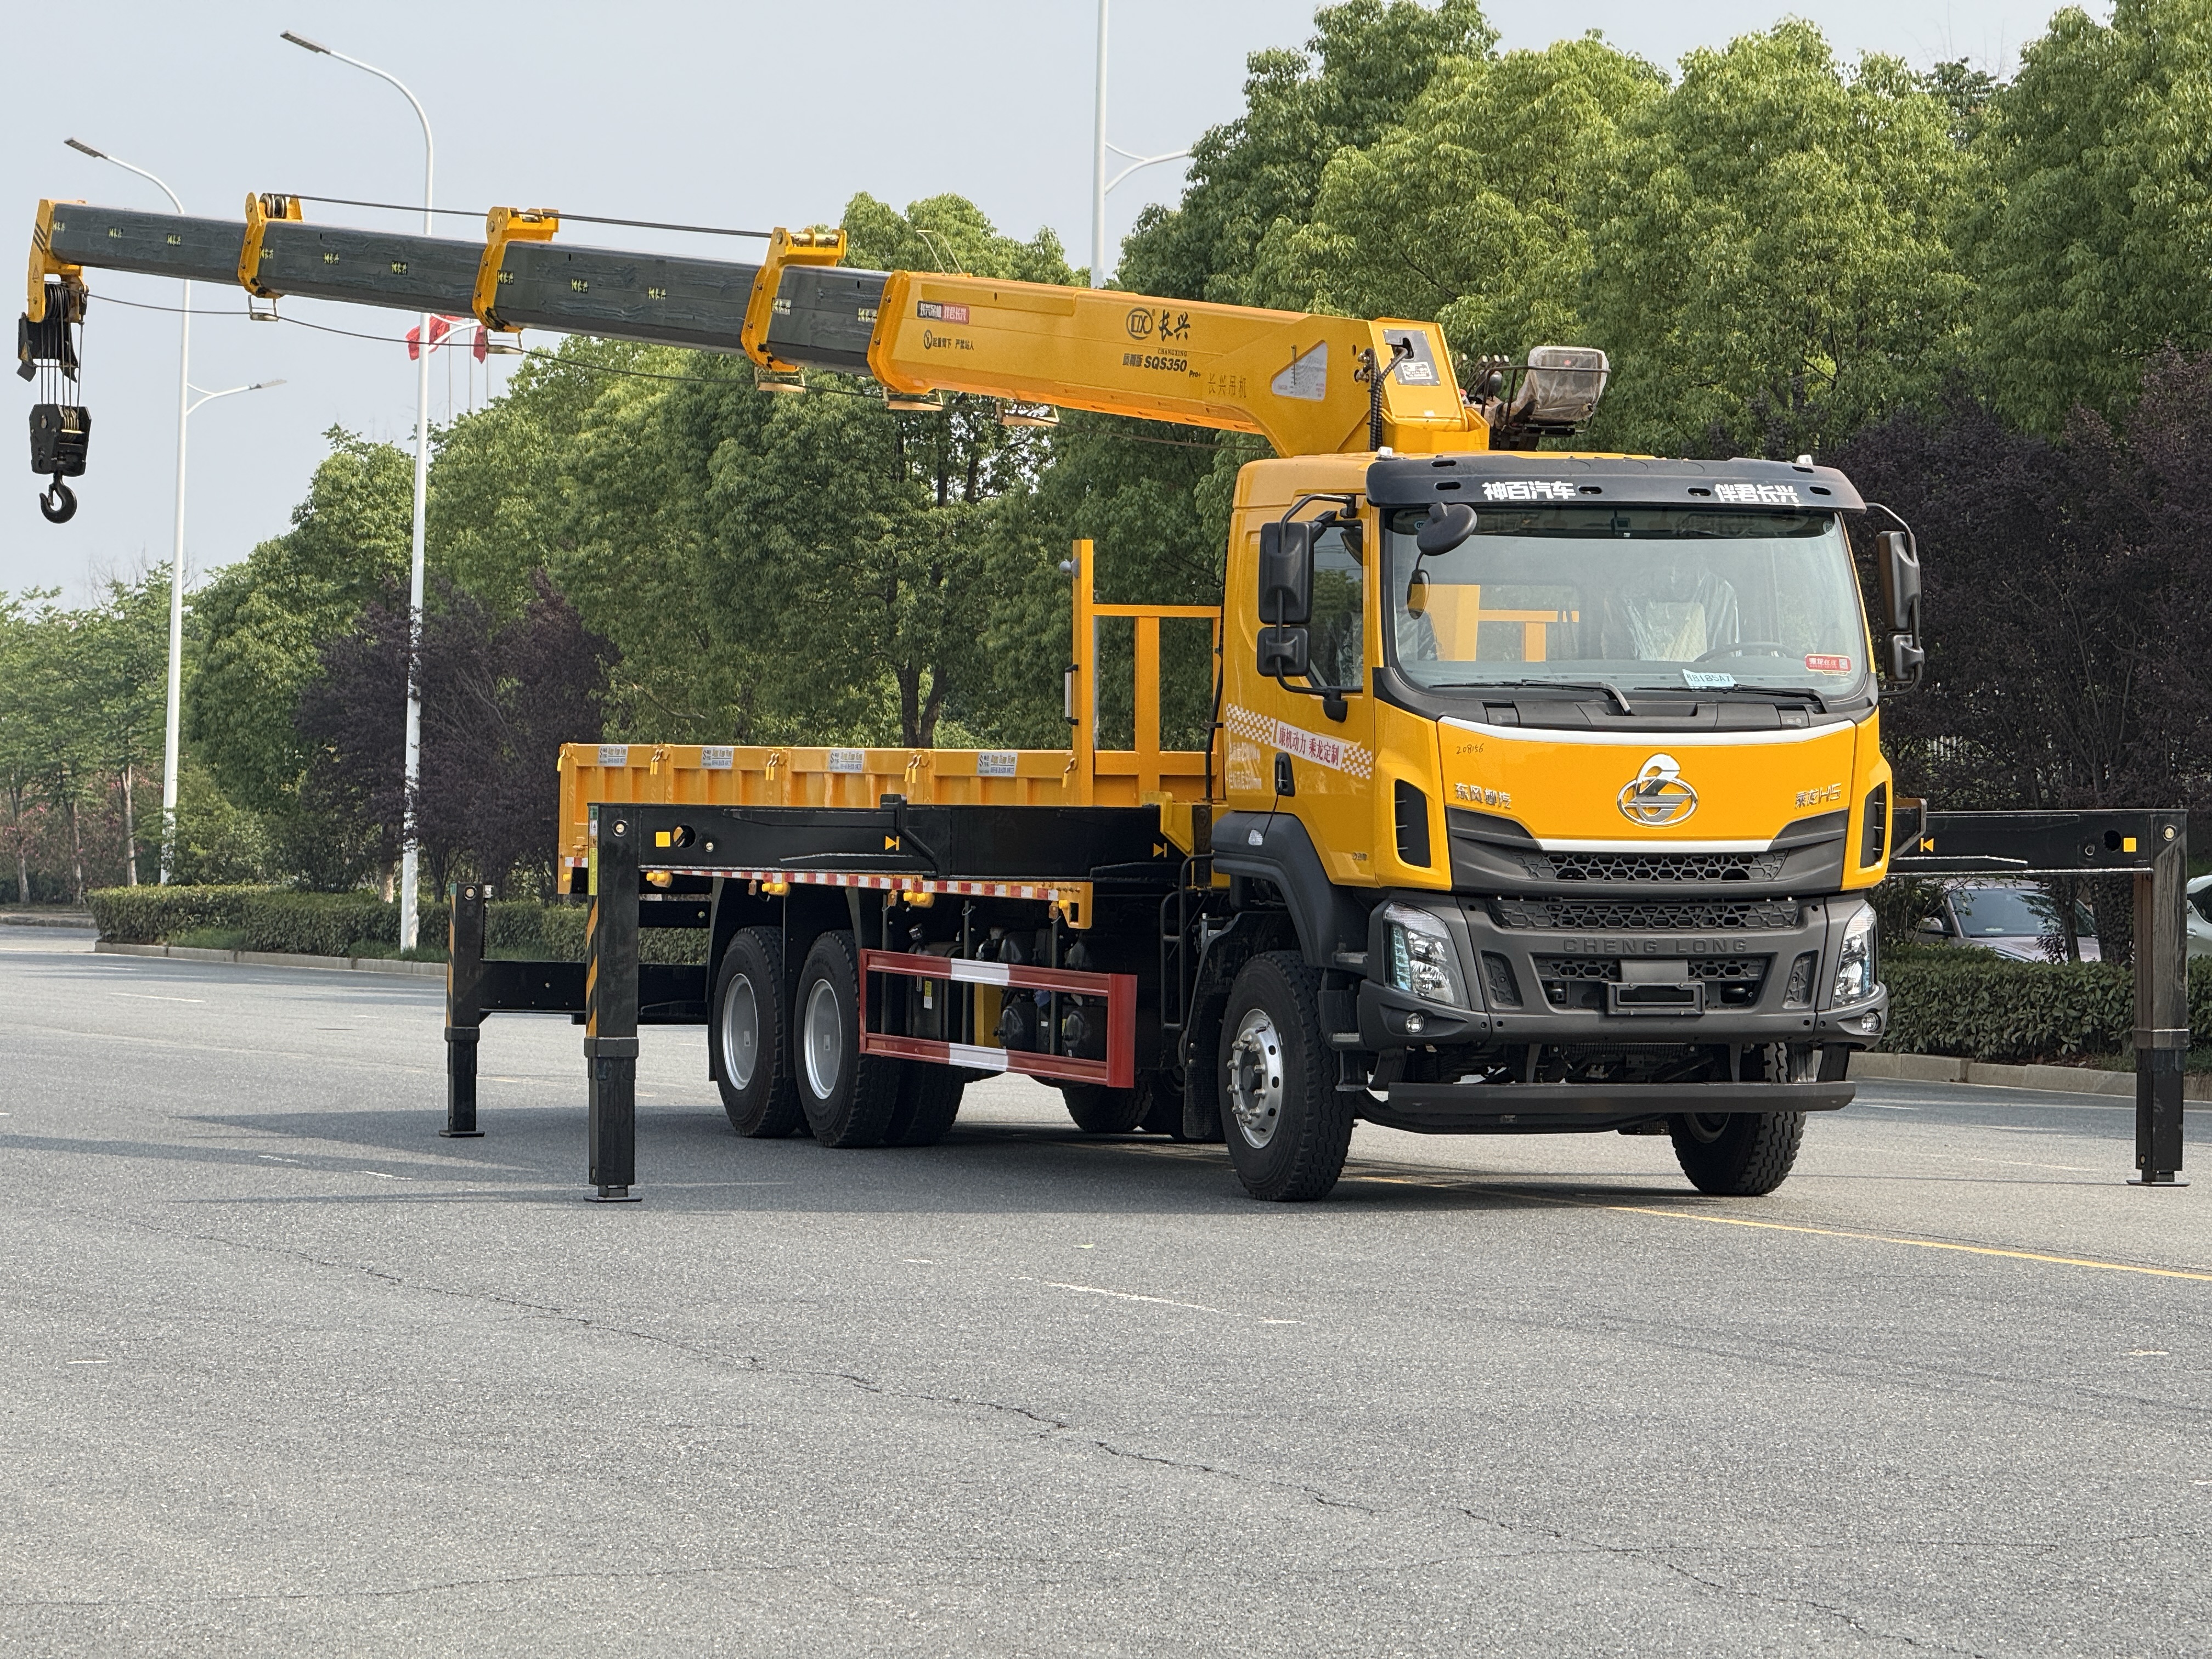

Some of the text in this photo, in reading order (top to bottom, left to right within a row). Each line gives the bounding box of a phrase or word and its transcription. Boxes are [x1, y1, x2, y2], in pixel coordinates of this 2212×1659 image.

[1158, 309, 1190, 342] 长兴
[1158, 348, 1187, 357] CHANGXING
[1144, 356, 1187, 372] SQS350
[1208, 373, 1246, 398] 长兴吊机
[1482, 481, 1576, 500] 神百汽车
[1714, 484, 1799, 503] 伴君长兴
[1278, 726, 1339, 766] 康机动力 乘龙定制
[1456, 743, 1484, 755] 208156
[1455, 782, 1512, 809] 东风柳汽
[1795, 783, 1842, 809] 乘龙H5
[1564, 938, 1747, 953] CHENG LONG
